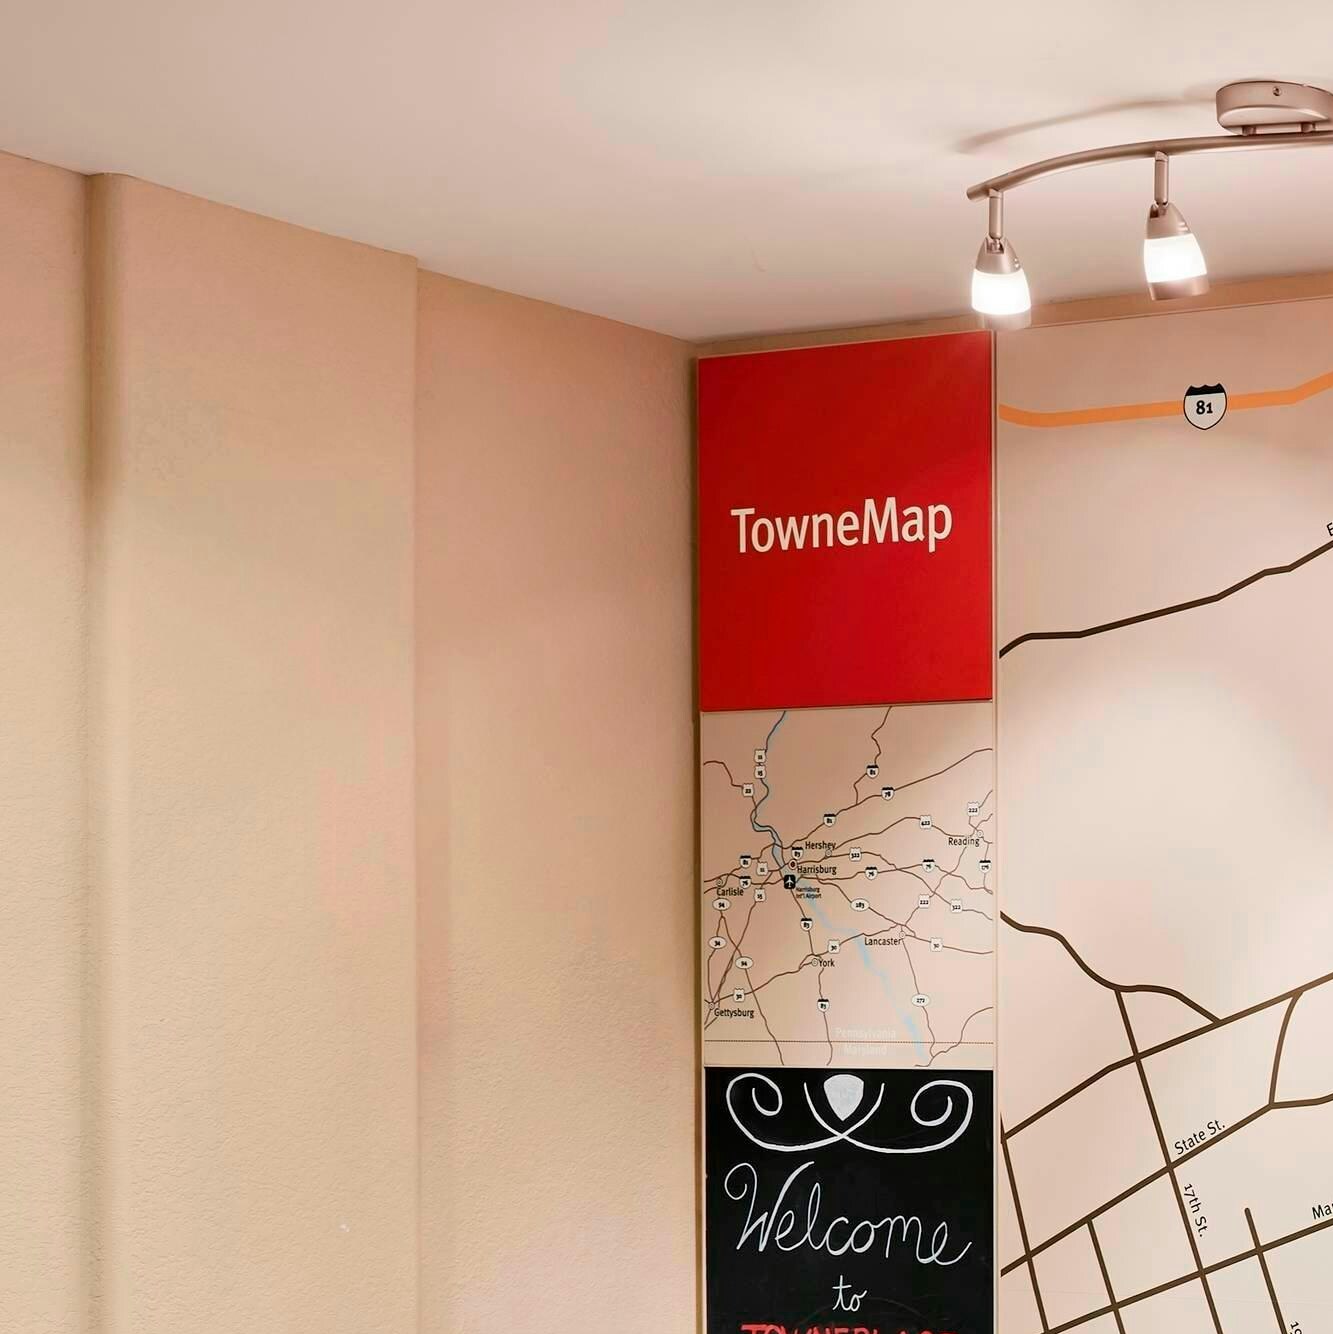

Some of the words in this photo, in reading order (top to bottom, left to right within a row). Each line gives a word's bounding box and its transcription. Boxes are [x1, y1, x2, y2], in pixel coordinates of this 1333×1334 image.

[1195, 400, 1214, 415] 81
[731, 497, 952, 552] TowneMap
[805, 841, 836, 850] Hershey
[948, 837, 979, 847] Reading
[797, 865, 836, 875] Harrisburg
[717, 888, 743, 896] Carlisle
[864, 937, 901, 945] Lancaster
[819, 958, 834, 967] York
[714, 1008, 754, 1018] Gettysburg
[1174, 1128, 1205, 1156] State
[1206, 1119, 1226, 1138] St.
[724, 1161, 972, 1265] Welcome
[1183, 1183, 1202, 1215] 17th
[1194, 1215, 1207, 1238] St.
[832, 1275, 867, 1312] to
